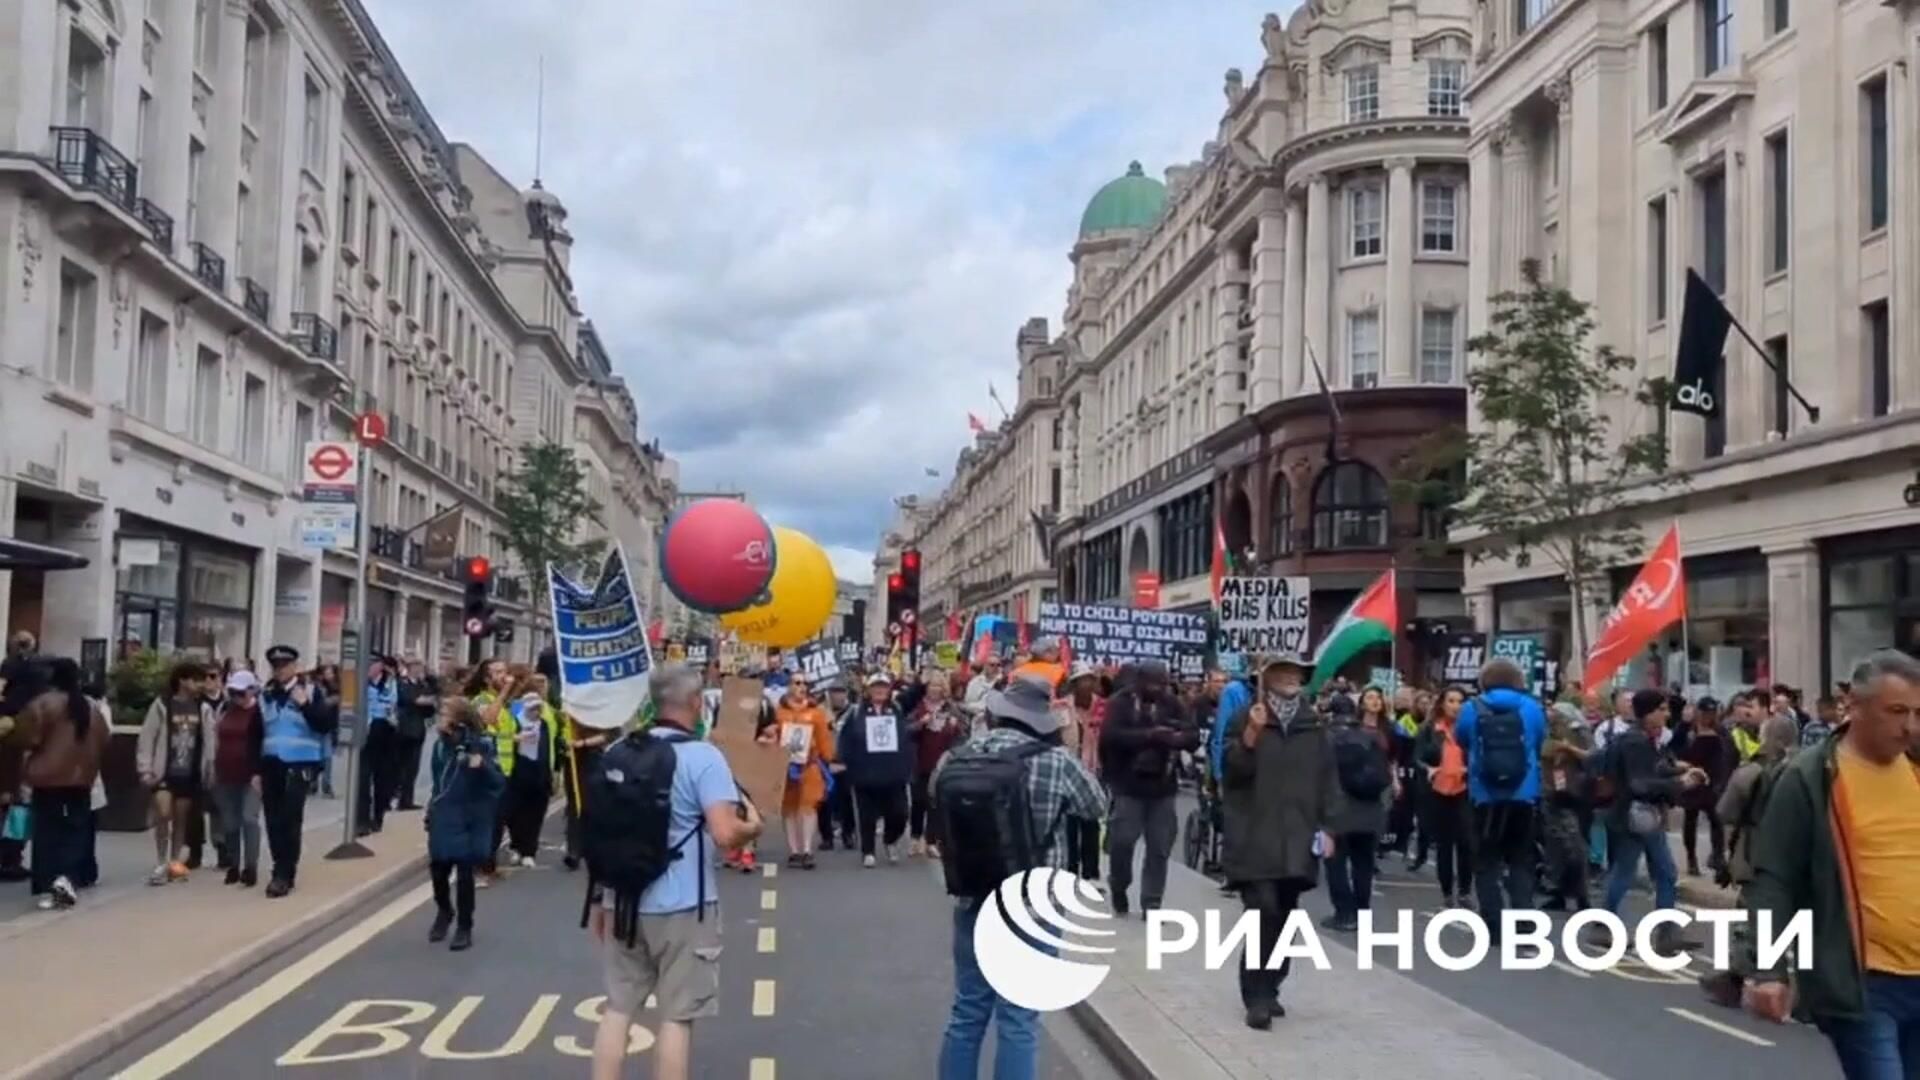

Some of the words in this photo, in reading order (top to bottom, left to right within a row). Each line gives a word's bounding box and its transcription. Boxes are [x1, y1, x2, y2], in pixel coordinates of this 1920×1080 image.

[1677, 377, 1714, 410] alo
[363, 417, 377, 438] L
[1221, 578, 1289, 598] MEDIA
[1040, 603, 1059, 617] NO
[1063, 604, 1081, 620] TO
[1084, 606, 1128, 623] CHILD
[1221, 598, 1260, 621] BIAS
[1267, 596, 1308, 622] KILLS
[1040, 618, 1103, 637] HURTING
[1106, 623, 1133, 640] THE
[1136, 625, 1207, 644] DISABLED
[1219, 626, 1306, 654] DEMOCRACY
[1069, 635, 1086, 650] TO
[1093, 637, 1161, 657] WELFARE
[1448, 646, 1484, 667] TAX
[1495, 640, 1533, 654] CUT
[592, 655, 649, 680] CUTS
[802, 648, 835, 672] TAX
[275, 994, 656, 1066] BUS
